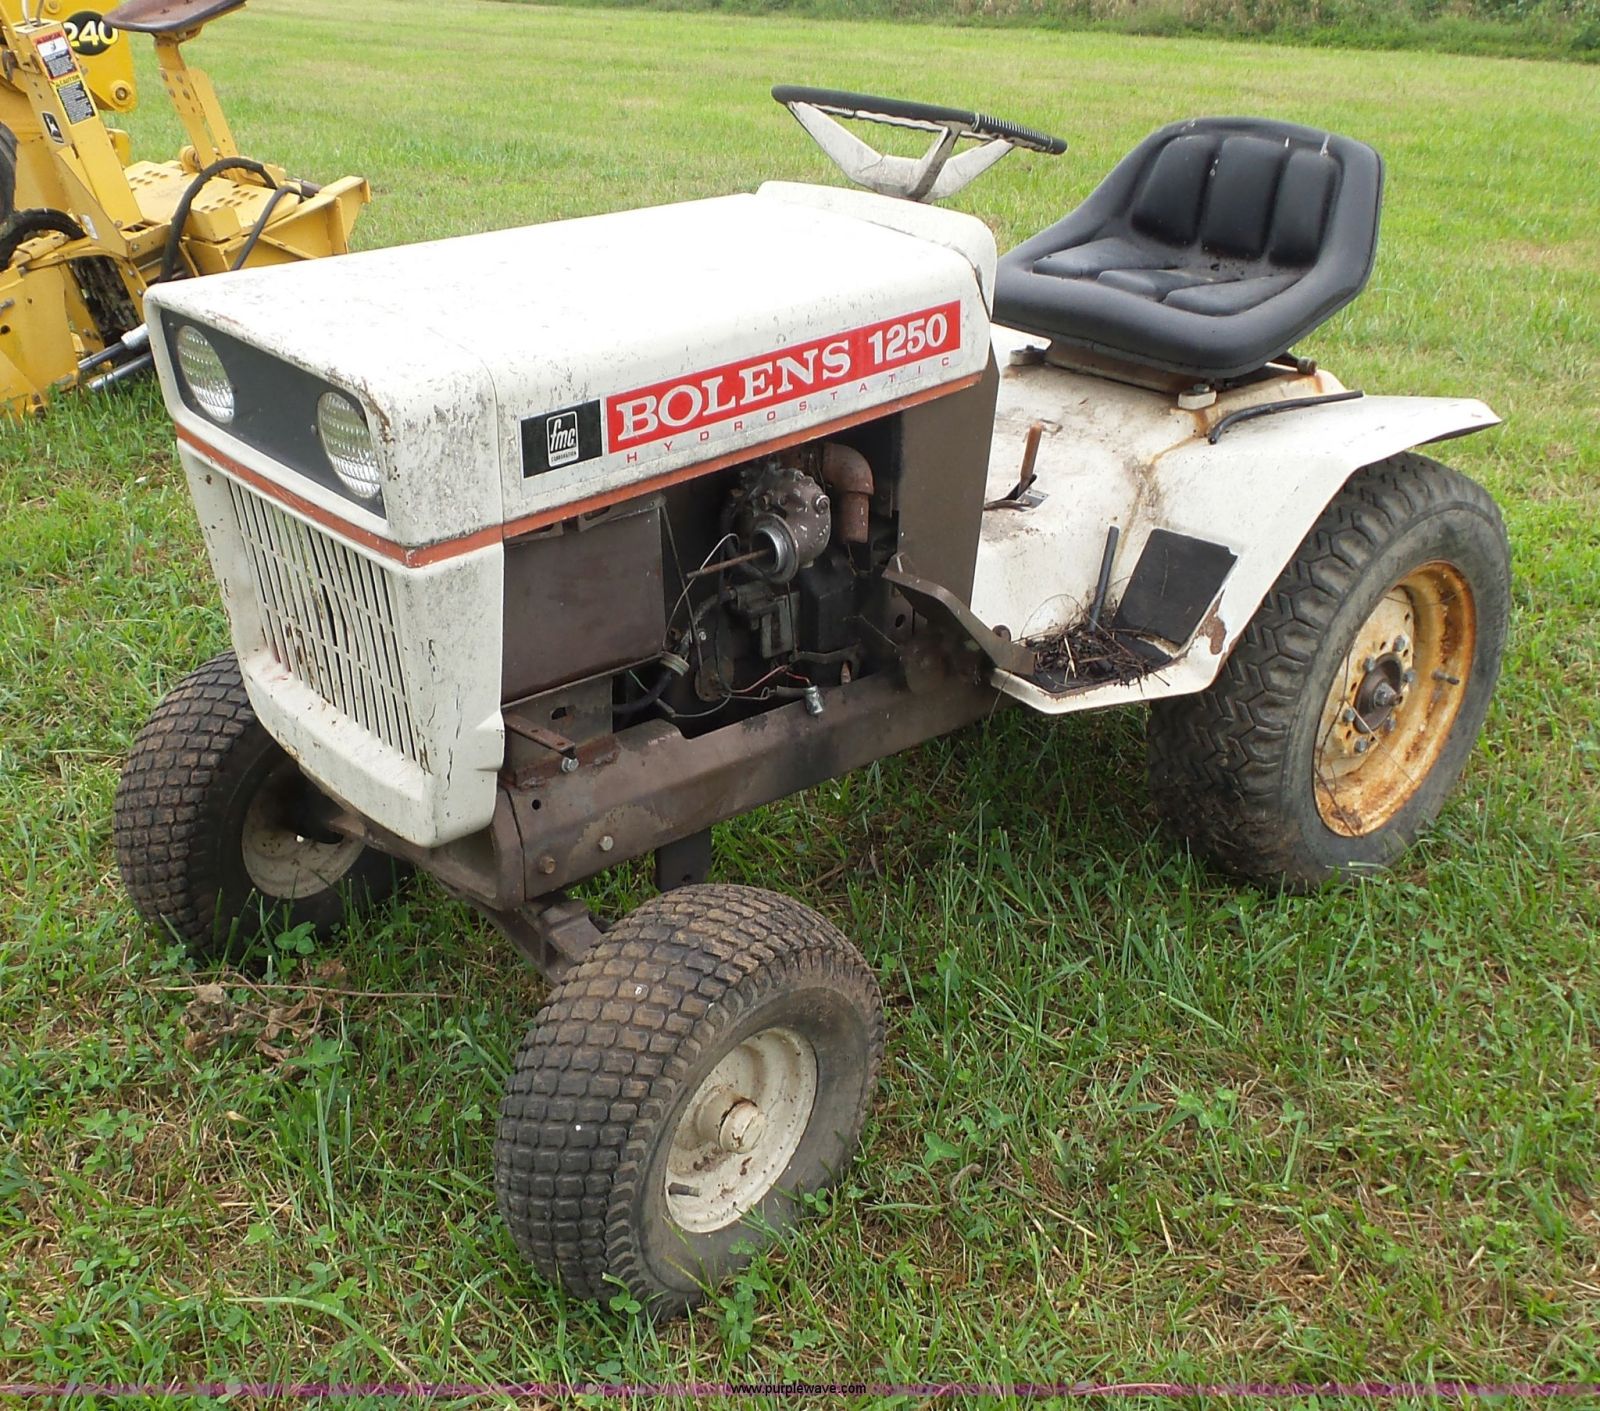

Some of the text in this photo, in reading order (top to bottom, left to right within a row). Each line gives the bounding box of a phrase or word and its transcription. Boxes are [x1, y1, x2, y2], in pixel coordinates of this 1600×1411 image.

[64, 20, 119, 48] 240
[616, 312, 948, 442] BOLENS 1250
[626, 356, 951, 464] HYDROSTATIC
[550, 418, 576, 452] fmc
